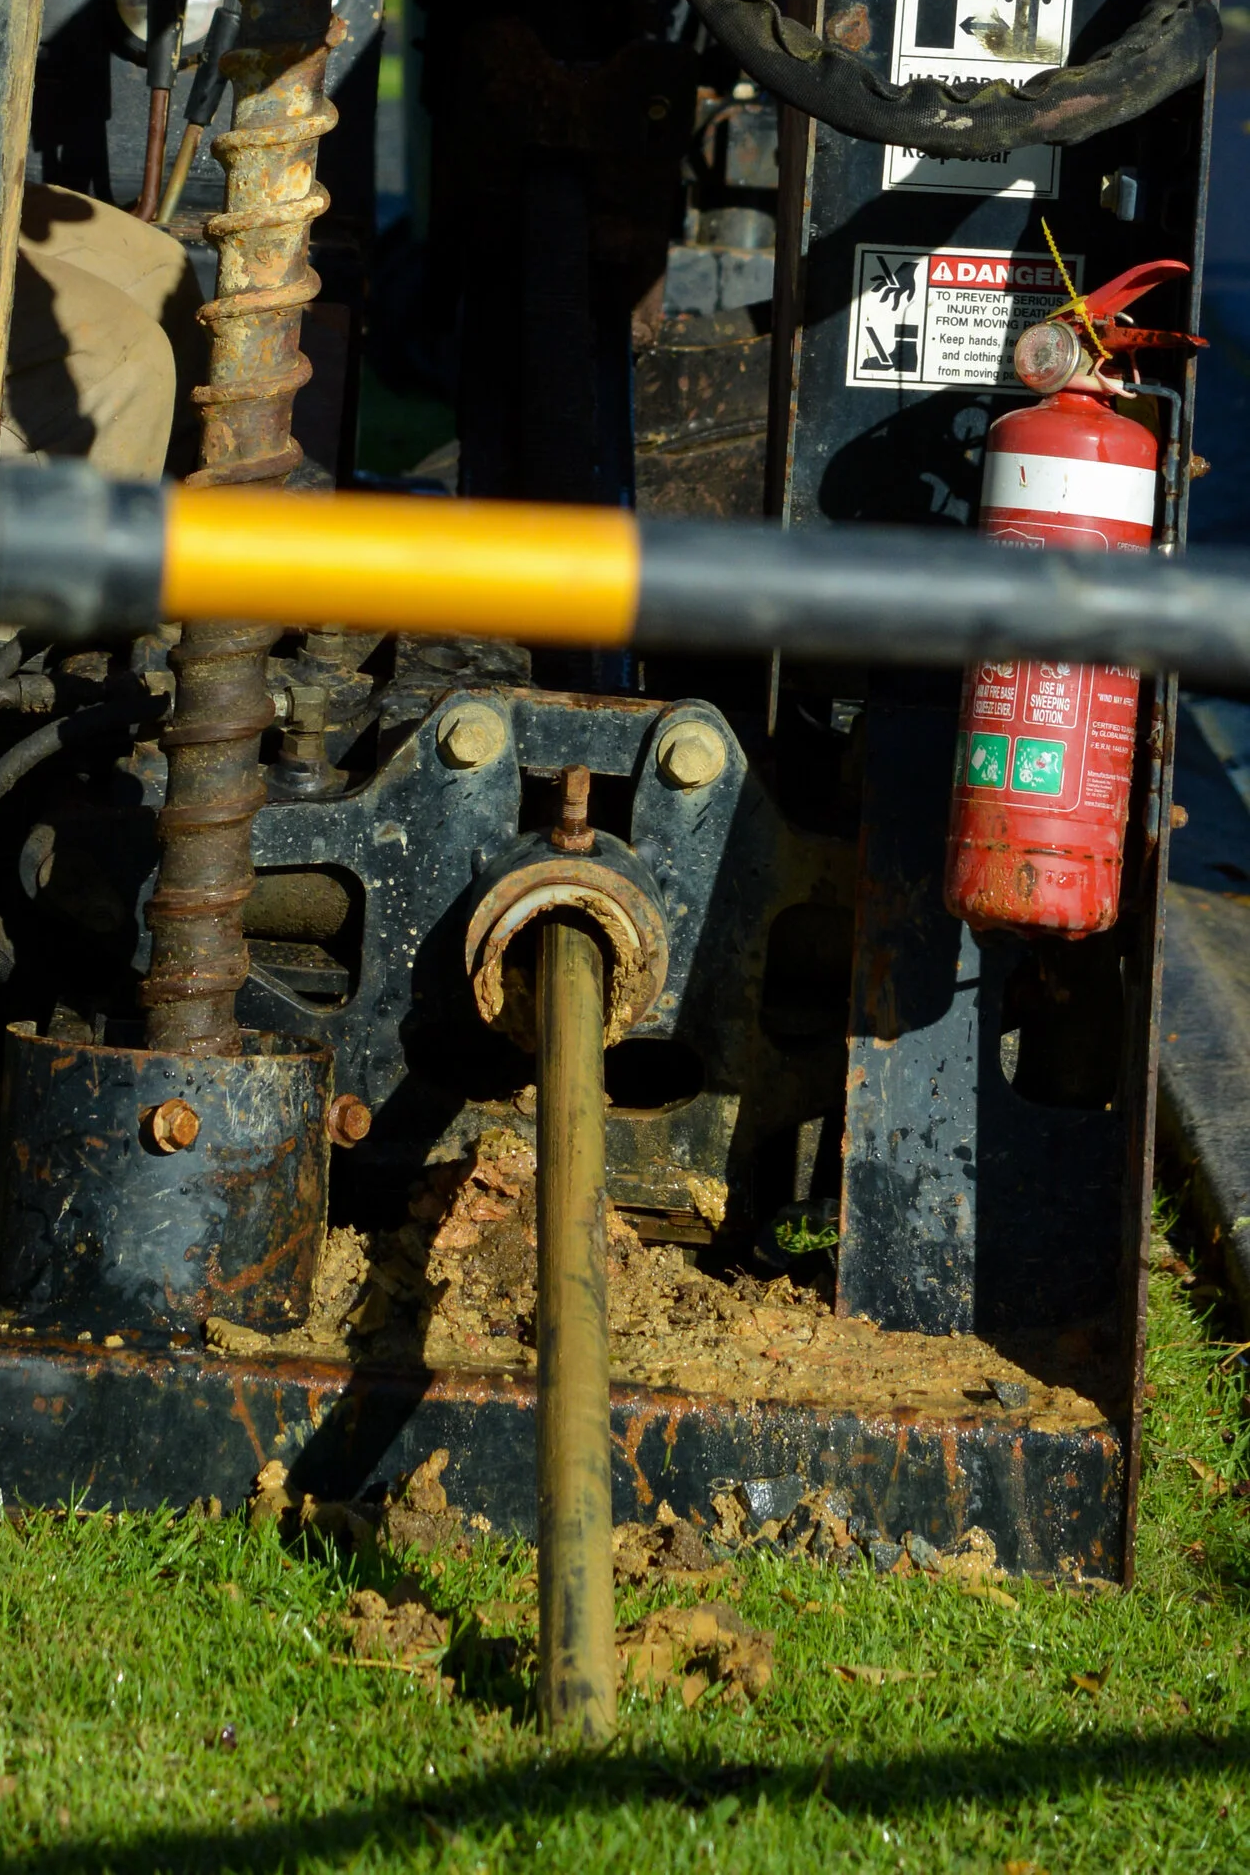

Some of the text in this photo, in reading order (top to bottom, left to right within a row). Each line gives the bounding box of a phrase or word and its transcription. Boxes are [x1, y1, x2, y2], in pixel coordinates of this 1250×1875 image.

[957, 263, 1072, 286] DANGER
[936, 291, 1064, 306] TO PREVENT SERIOUS
[947, 304, 987, 315] INJURY
[992, 306, 1009, 316] OR
[936, 316, 968, 327] FROM
[973, 318, 1018, 330] MOVING
[939, 333, 965, 346] Keep
[969, 334, 1001, 347] hands,
[942, 351, 960, 361] and
[964, 351, 1002, 365] clothing
[938, 365, 960, 376] from
[964, 368, 999, 381] moving
[1000, 686, 1015, 700] BASE
[1039, 681, 1065, 696] USE IN
[1030, 694, 1070, 711] SWEEPING
[1032, 709, 1064, 724] MOTION.
